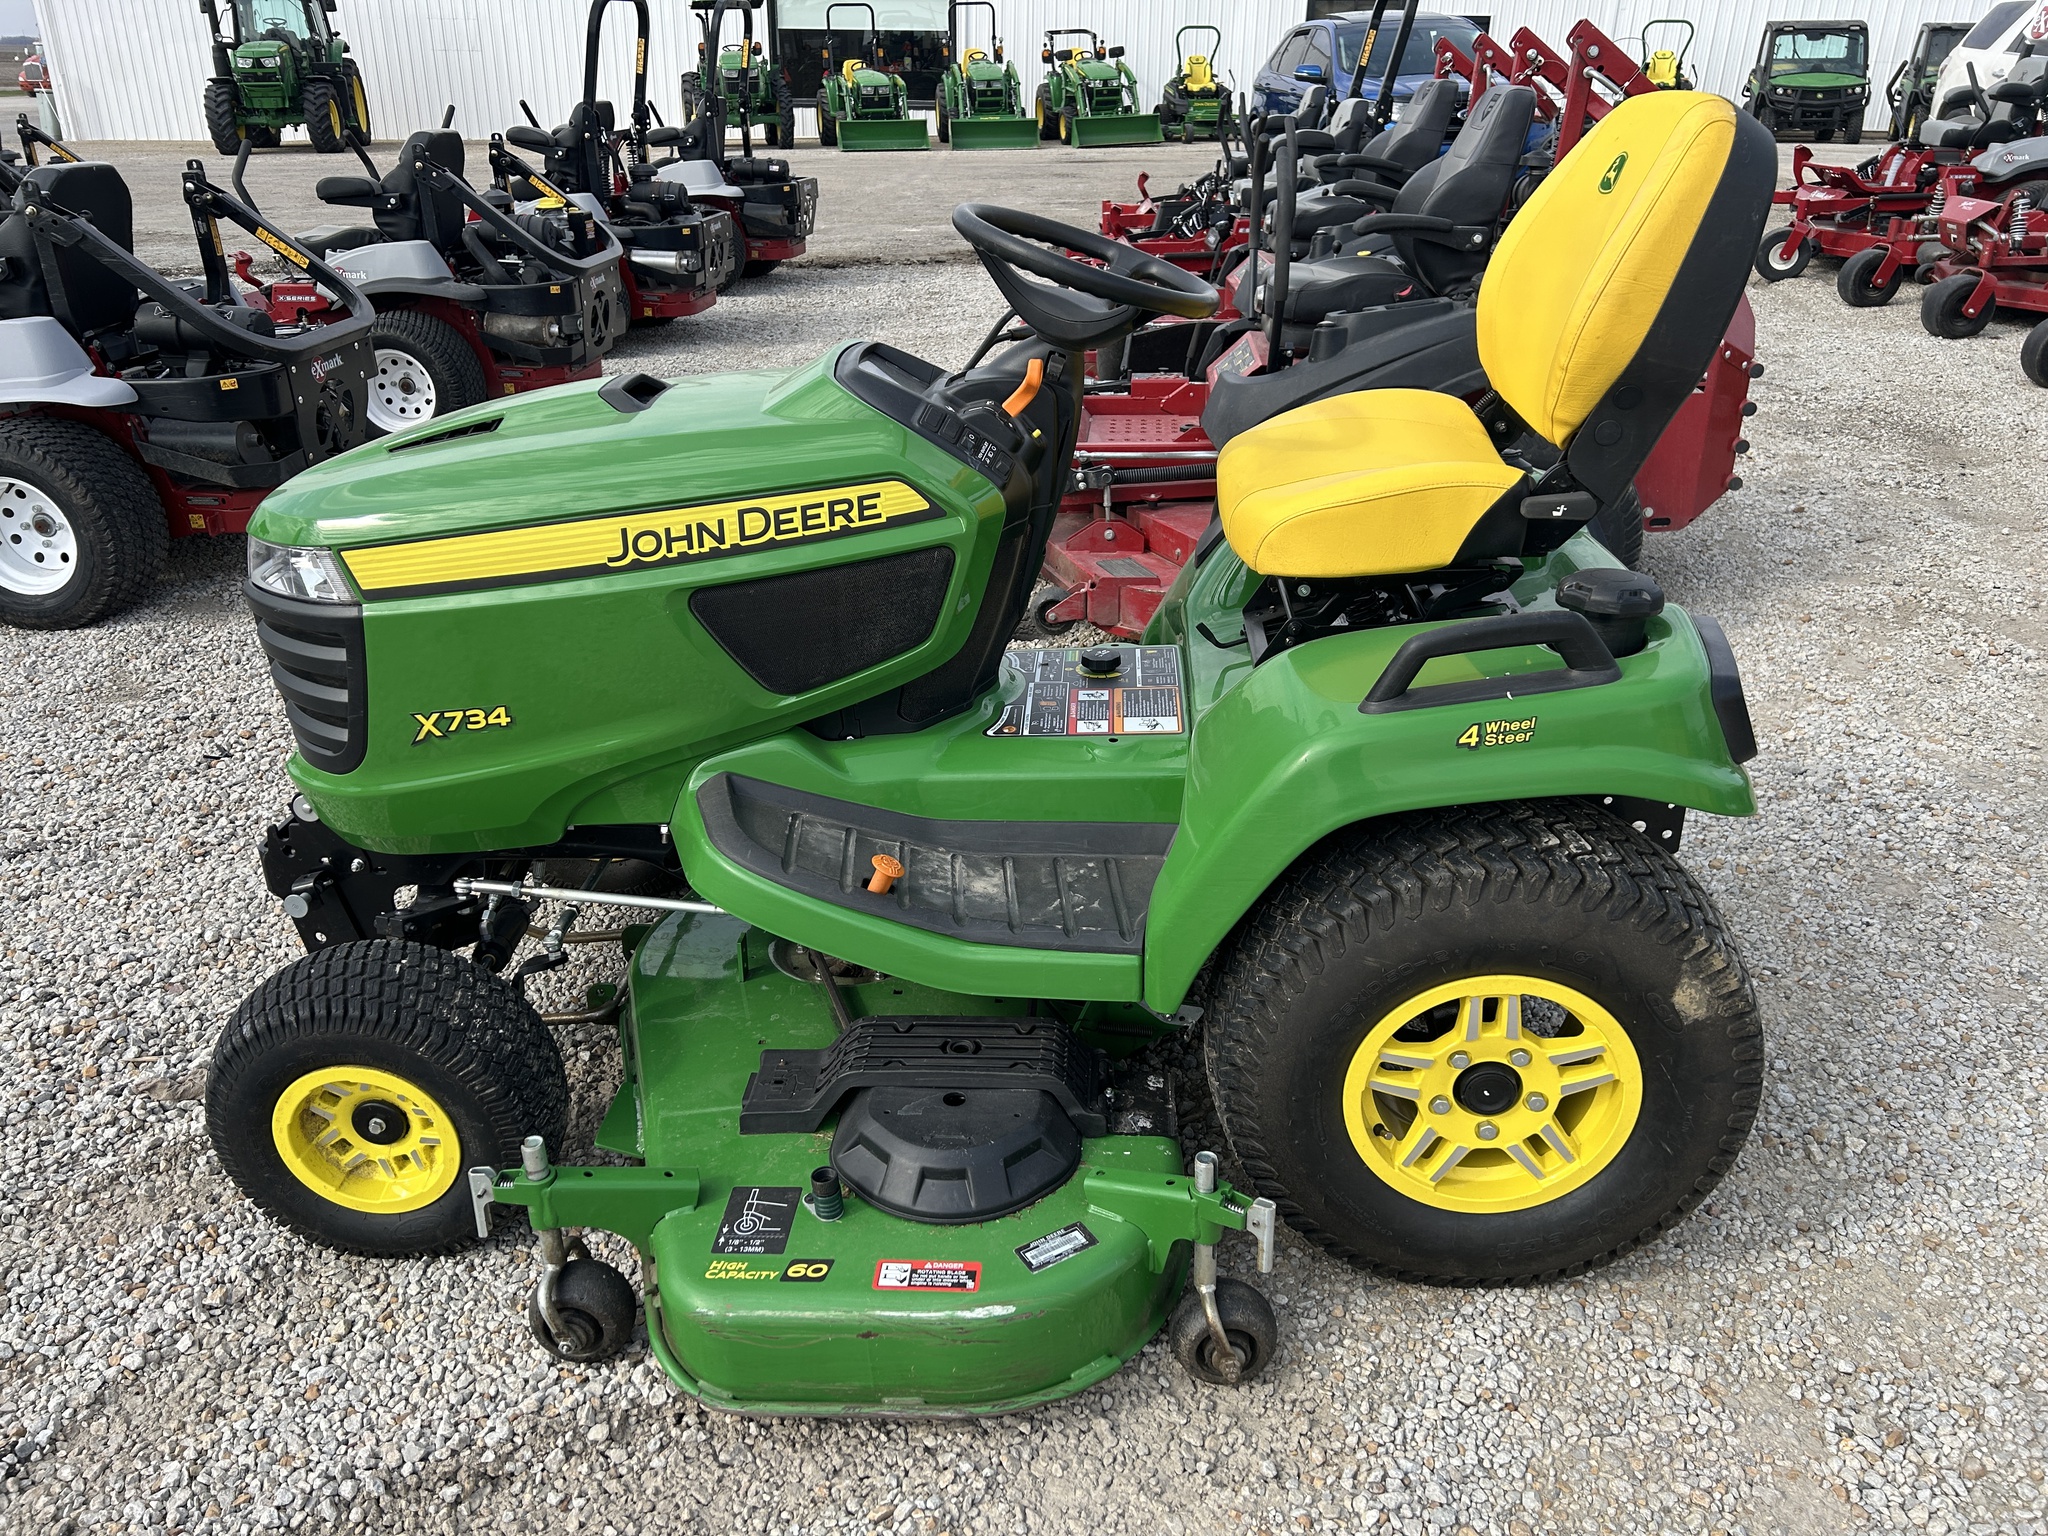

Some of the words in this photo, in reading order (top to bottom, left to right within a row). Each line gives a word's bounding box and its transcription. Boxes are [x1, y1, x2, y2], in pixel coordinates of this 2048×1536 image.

[606, 517, 728, 565] JOHN
[737, 491, 884, 544] DEERE
[411, 705, 511, 745] X734
[1458, 724, 1480, 748] 4
[1485, 717, 1537, 734] Wheel
[1484, 731, 1534, 747] Steer
[704, 1269, 780, 1280] CAPACITY
[786, 1263, 829, 1278] 60
[709, 1260, 748, 1271] HIGH
[933, 1262, 964, 1270] DANGER
